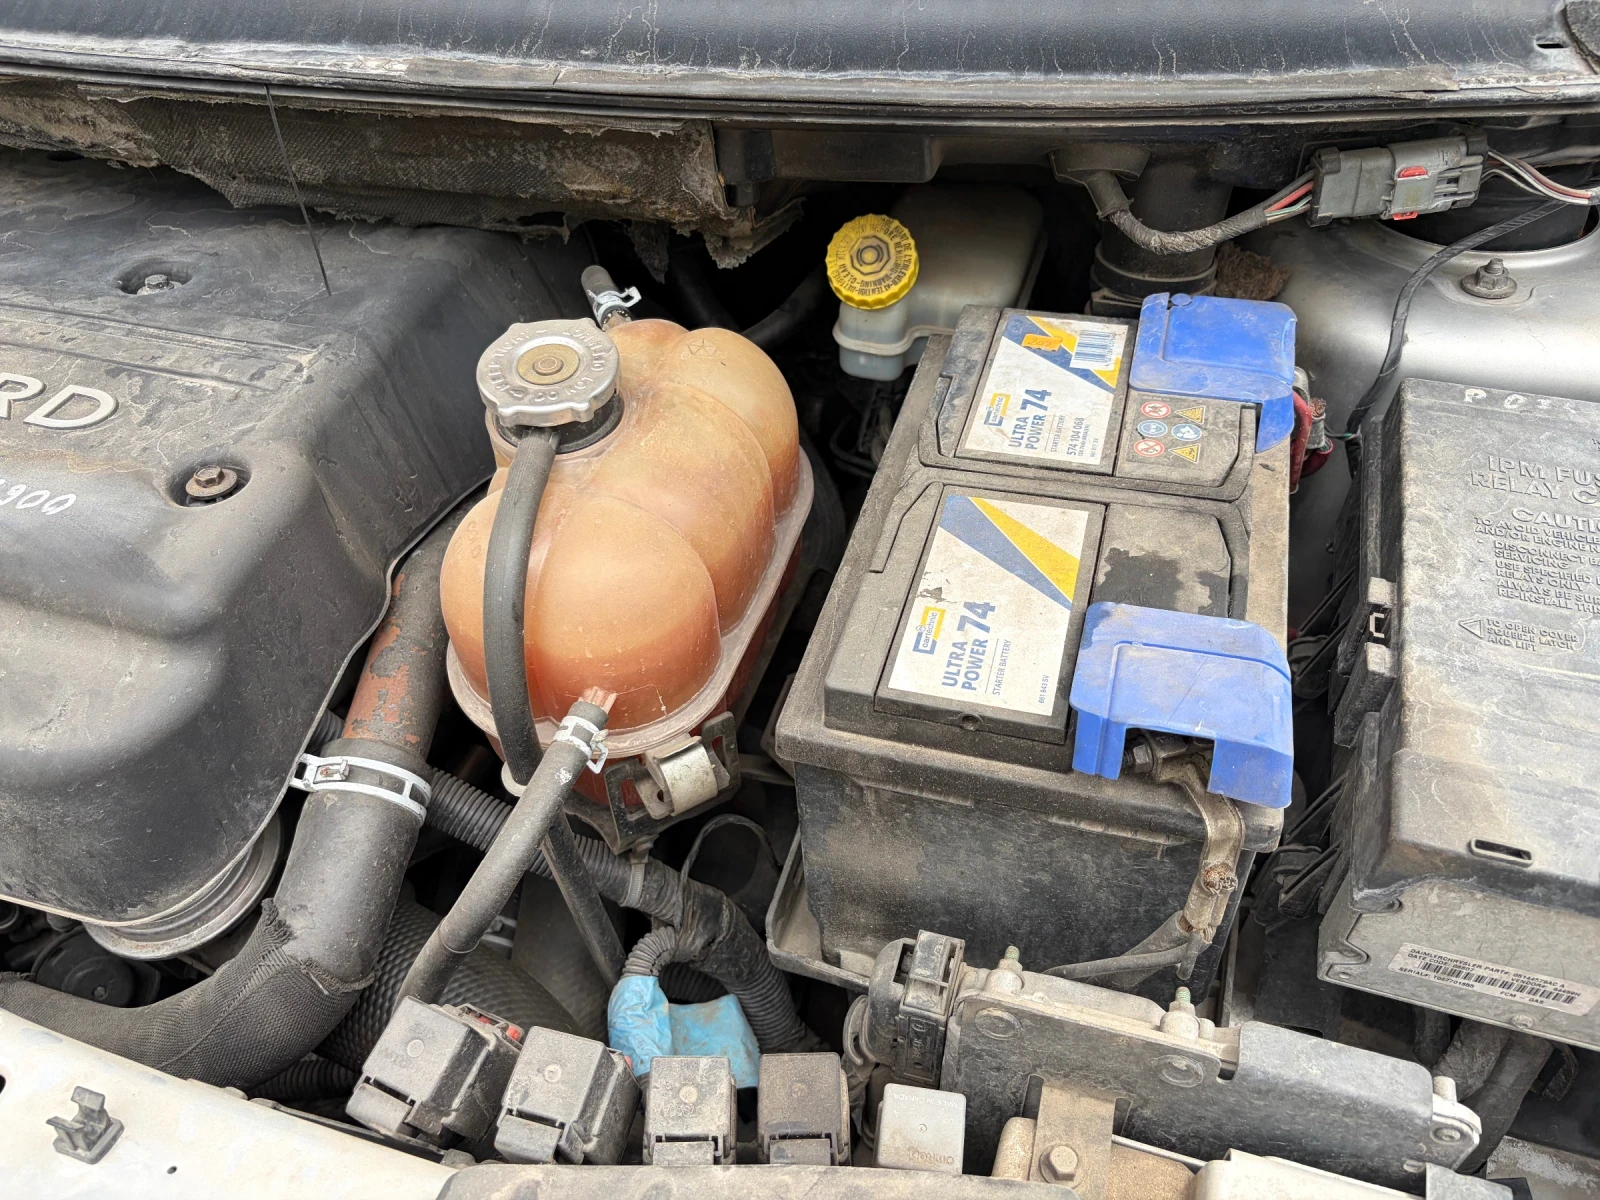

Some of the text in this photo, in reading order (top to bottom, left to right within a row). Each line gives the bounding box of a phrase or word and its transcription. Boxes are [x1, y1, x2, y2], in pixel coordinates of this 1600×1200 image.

[1008, 389, 1052, 447] ULTRA 74
[1025, 414, 1046, 450] POWER
[1050, 414, 1066, 453] STARTER BATTERY
[1066, 417, 1084, 456] 574 104 068
[1488, 455, 1546, 480] IPM
[1470, 470, 1558, 500] RELAY
[1474, 516, 1494, 527] TO
[1496, 520, 1540, 535] AVOID
[1511, 507, 1600, 533] CAUTI
[1494, 540, 1586, 564] DISCONNECT
[1494, 549, 1569, 570] SERVICING
[1495, 559, 1521, 572] USE
[1523, 565, 1592, 584] SPECIFIED
[1496, 568, 1544, 585] RELAYS
[1548, 578, 1584, 592] ONLY
[1496, 579, 1551, 597] ALWAYS
[1555, 589, 1572, 600] BE
[1497, 587, 1573, 610] RE-INSTALL
[922, 612, 938, 648] cartechnic
[1486, 618, 1579, 643] TO OPEN COVER
[1487, 627, 1575, 651] SQUEEZE LATCH
[941, 600, 996, 688] ULTRA 74
[1487, 635, 1537, 652] AND LIFT
[961, 638, 989, 691] POWER
[992, 639, 1012, 696] STARTER BATTERY
[1407, 953, 1427, 962] DATE
[1410, 948, 1483, 970] DAIMLERCHRYSLER
